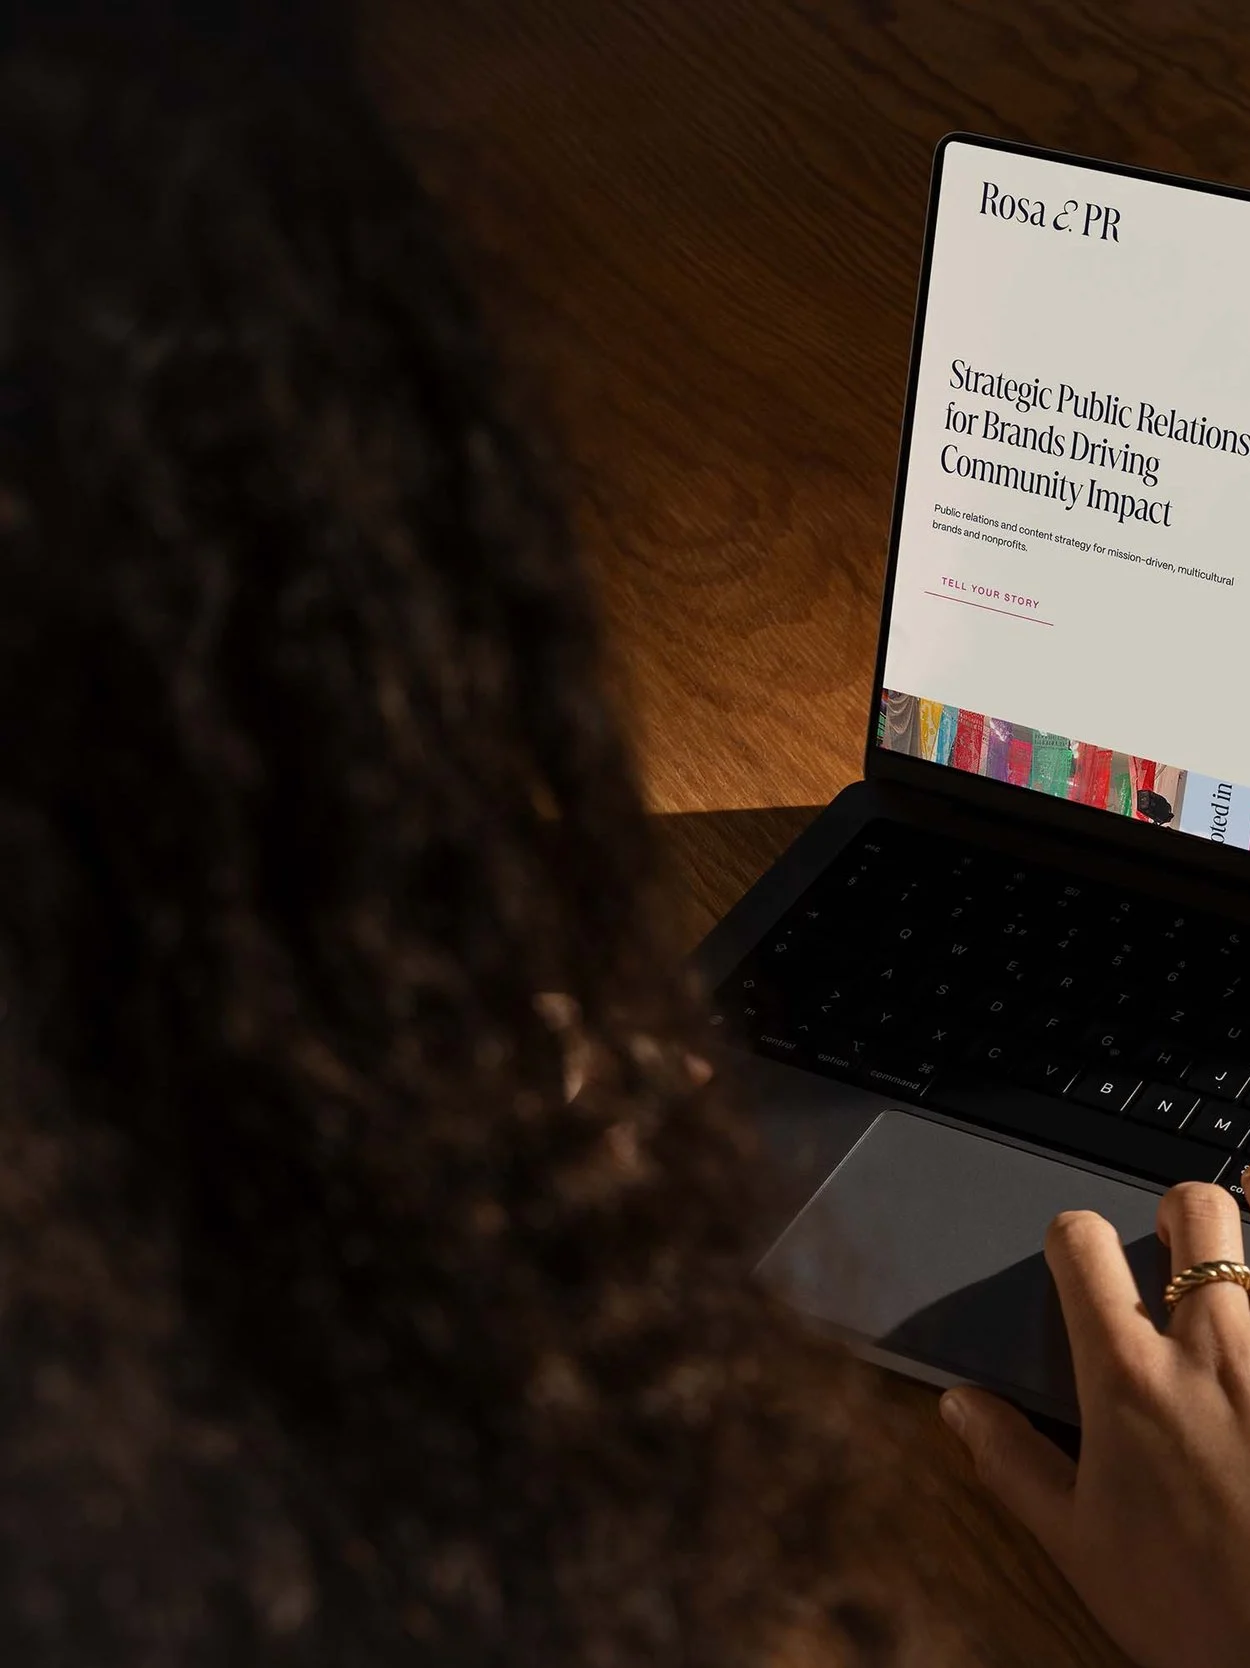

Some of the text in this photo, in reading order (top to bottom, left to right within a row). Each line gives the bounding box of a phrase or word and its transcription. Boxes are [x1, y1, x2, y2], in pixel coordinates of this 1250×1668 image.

[979, 180, 1046, 228] Rosa
[1081, 202, 1121, 243] PR
[949, 359, 1250, 456] Strategic Public Relations
[944, 401, 1161, 488] for Brands Driving
[940, 444, 1173, 527] Community Impact
[932, 519, 1029, 552] brands and nonprofits.
[934, 503, 1235, 586] Public relations and content strategy for mission-driven, multicultural
[941, 576, 1040, 609] TELL YOUR STORY
[1212, 782, 1232, 802] in
[951, 907, 963, 918] 2
[899, 928, 913, 940] Q
[1003, 923, 1016, 934] 3
[951, 943, 968, 956] W
[1057, 939, 1069, 949] 4
[1005, 960, 1019, 972] E
[1111, 955, 1125, 967] 5
[880, 968, 893, 980] A
[1167, 971, 1180, 982] 6
[1060, 976, 1073, 988] R
[935, 984, 950, 995] S
[1222, 987, 1235, 998] 7
[1117, 993, 1130, 1005] T
[989, 1000, 1004, 1012] D
[880, 1011, 893, 1023] Y
[1045, 1017, 1059, 1028] F
[1170, 1010, 1185, 1023] Z
[931, 1029, 947, 1041] X
[1227, 1027, 1242, 1039] U
[761, 1035, 796, 1049] control
[1101, 1035, 1114, 1046] G
[987, 1047, 1002, 1059] C
[1156, 1052, 1172, 1064] H
[818, 1054, 848, 1067] option
[1046, 1064, 1059, 1076] V
[1214, 1071, 1228, 1081] J
[870, 1069, 921, 1089] command
[1100, 1082, 1114, 1094] B
[1157, 1100, 1173, 1113] N
[1214, 1118, 1232, 1131] M
